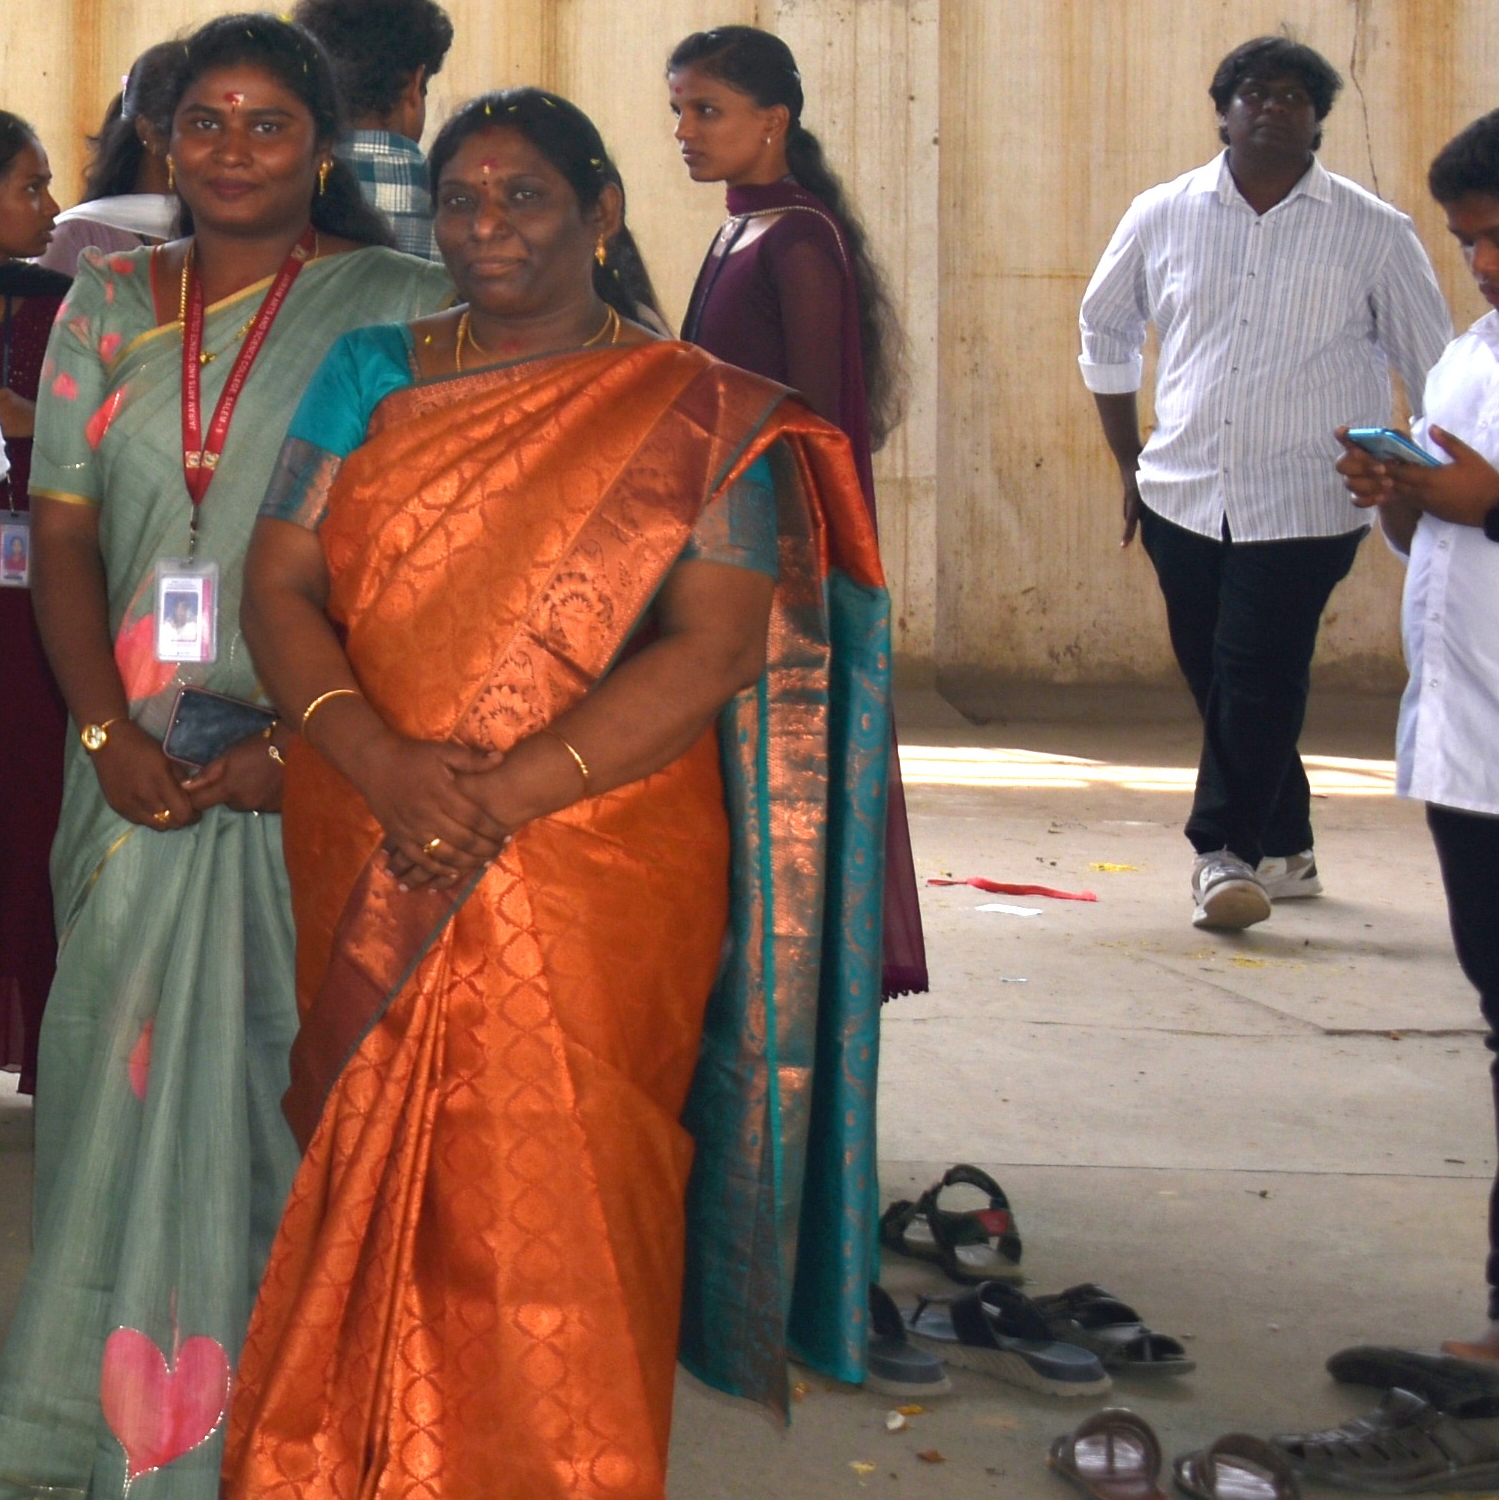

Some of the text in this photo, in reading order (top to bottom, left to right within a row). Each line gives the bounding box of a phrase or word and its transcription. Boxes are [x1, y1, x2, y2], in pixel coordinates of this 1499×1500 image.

[265, 296, 279, 315] ARTS
[258, 315, 269, 329] AND
[189, 332, 197, 361] SCIENCE
[243, 329, 262, 360] SCIENCE
[219, 395, 233, 423] SALEM
